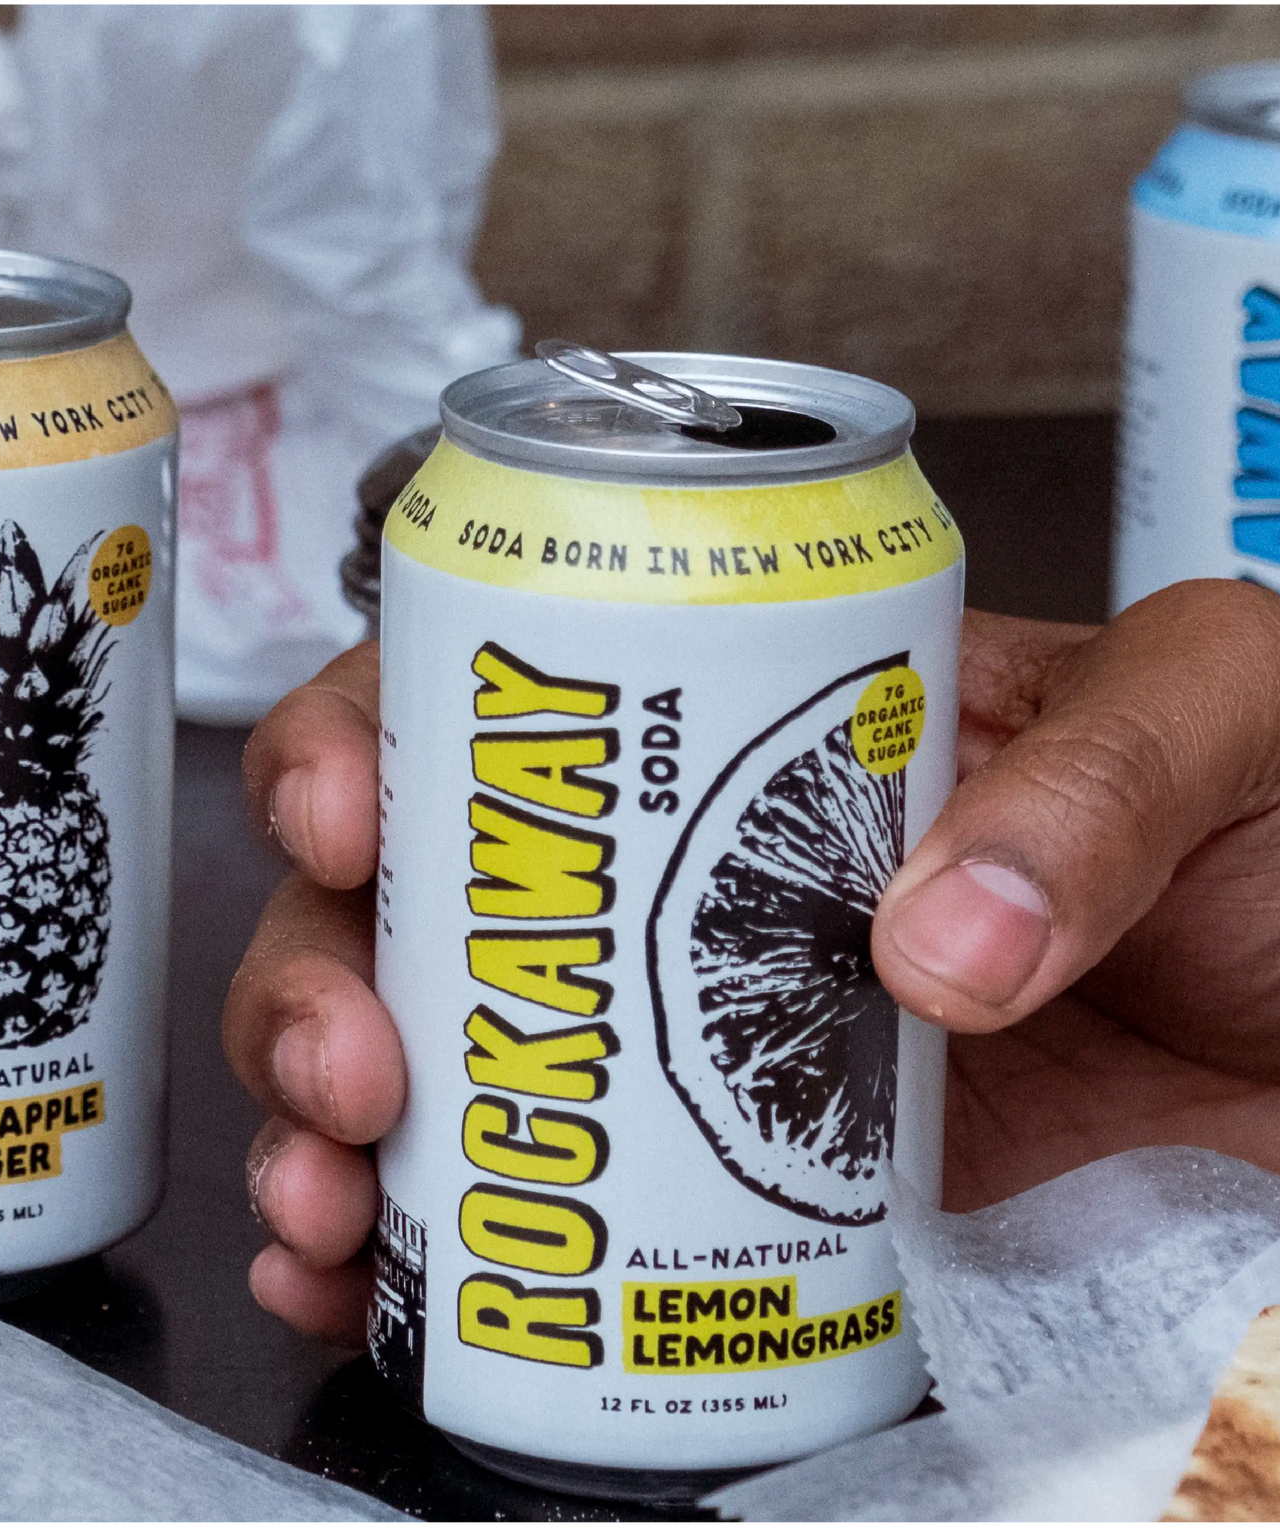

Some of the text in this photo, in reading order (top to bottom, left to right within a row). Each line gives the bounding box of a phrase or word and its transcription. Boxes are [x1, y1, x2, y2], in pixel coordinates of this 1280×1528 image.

[31, 403, 104, 438] YORK
[106, 387, 153, 423] CITY
[402, 489, 437, 531] SODA
[116, 541, 134, 558] 7G
[458, 516, 933, 577] SODA BORN IN NEW YORK CITY
[91, 551, 151, 582] ORGANIC
[107, 574, 142, 596] CANE
[102, 590, 145, 615] SUGAR
[884, 684, 905, 702] 7G
[856, 695, 925, 727] ORGANIC
[872, 719, 913, 743] CANE
[639, 687, 683, 816] SODA
[867, 737, 916, 763] SUGAR
[457, 641, 622, 1370] ROCKAWAY
[13, 1204, 44, 1221] ML)
[626, 1233, 848, 1270] ALL-NATURAL
[633, 1284, 791, 1324] LEMON
[632, 1299, 896, 1368] LEMONGRASS
[601, 1394, 788, 1414] 12 FL OZ (355 ML)
